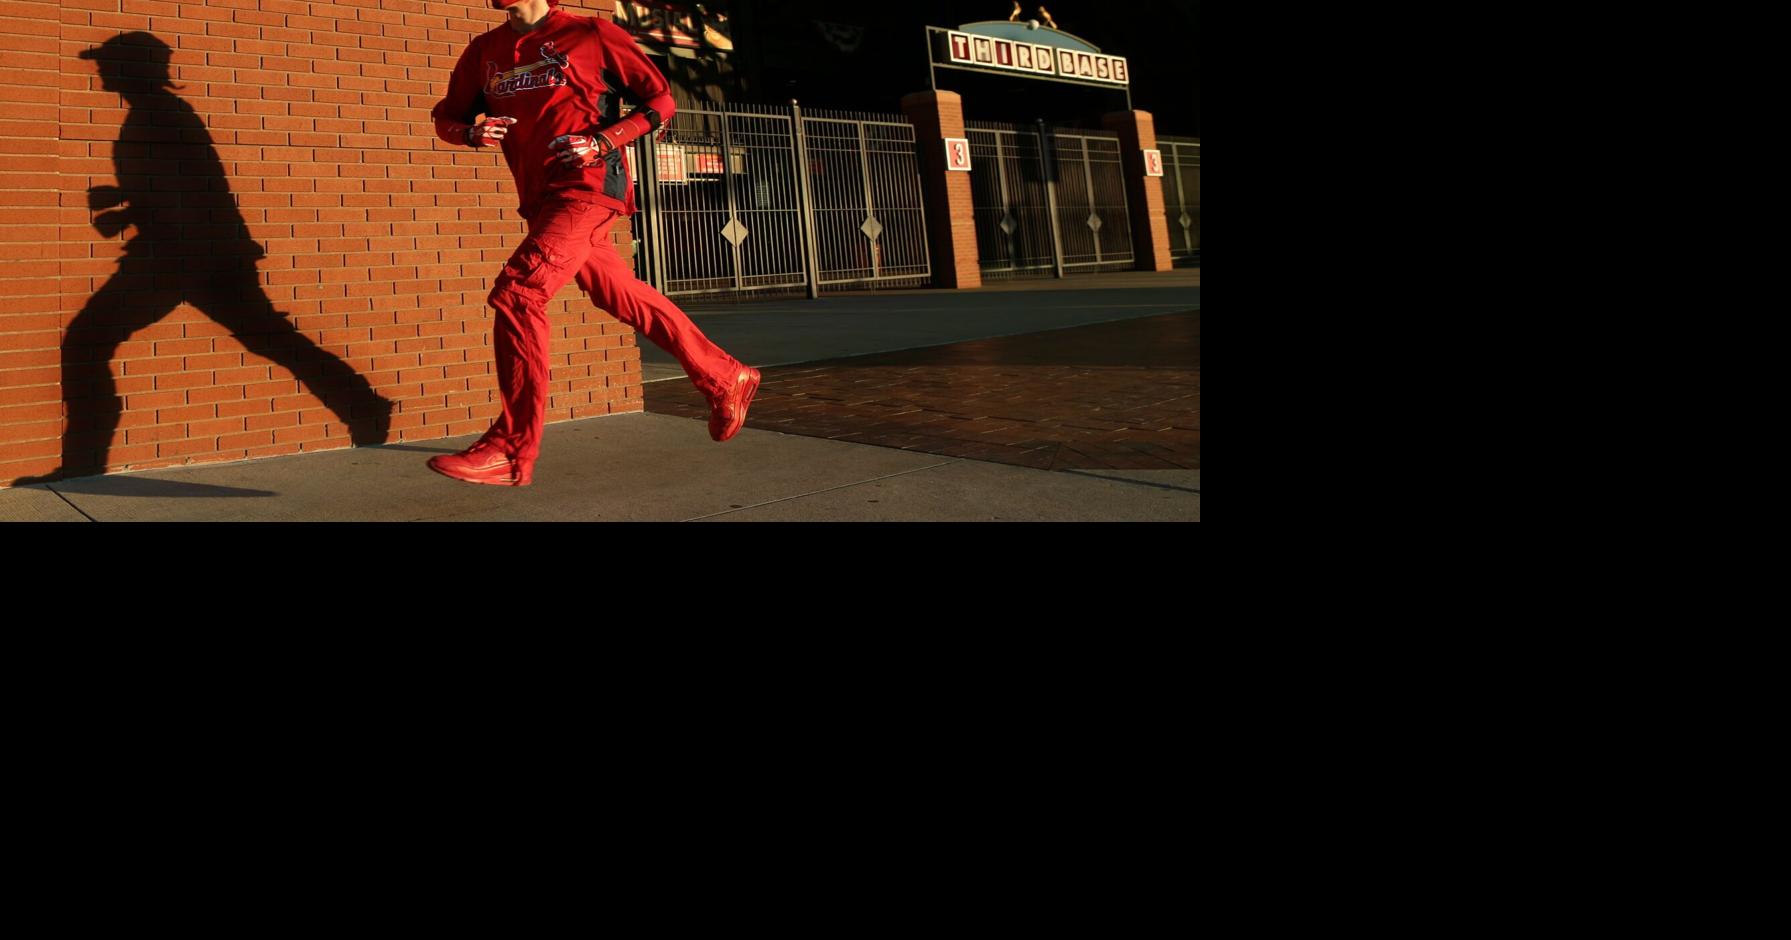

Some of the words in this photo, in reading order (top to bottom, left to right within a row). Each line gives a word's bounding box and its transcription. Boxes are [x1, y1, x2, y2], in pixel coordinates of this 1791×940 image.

[953, 35, 1053, 72] THIRD
[1060, 51, 1126, 81] BASE
[484, 62, 567, 97] Cardinals
[953, 143, 965, 167] 3
[1151, 154, 1160, 174] 3
